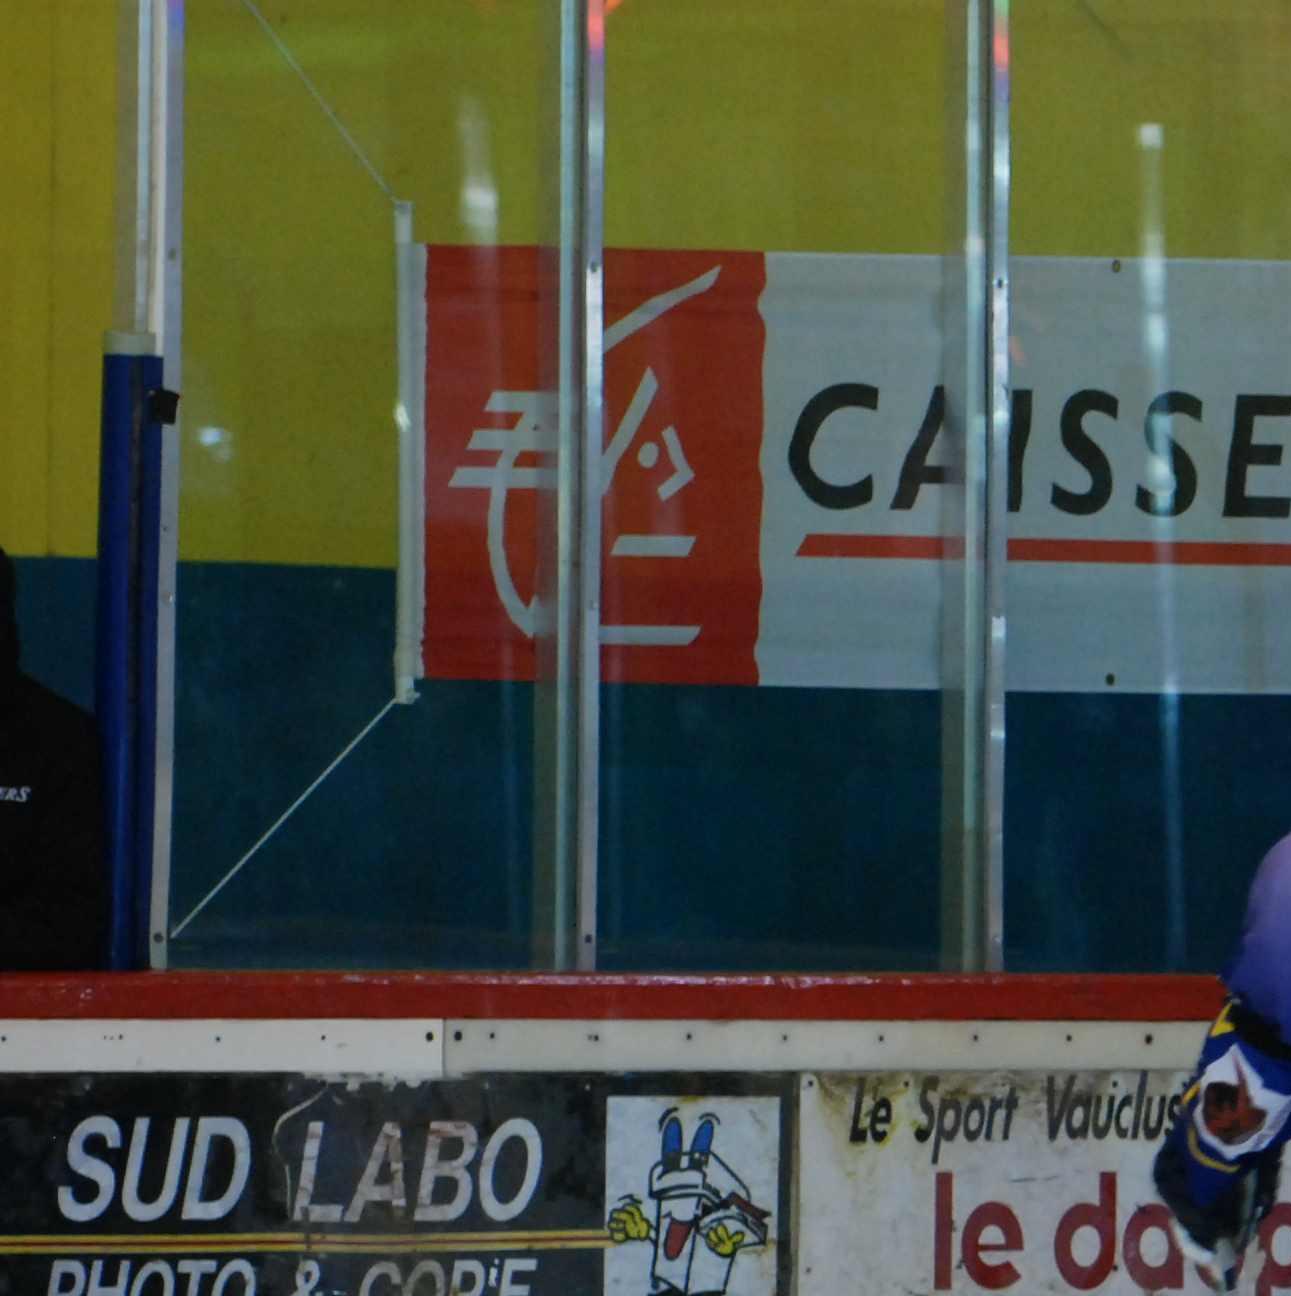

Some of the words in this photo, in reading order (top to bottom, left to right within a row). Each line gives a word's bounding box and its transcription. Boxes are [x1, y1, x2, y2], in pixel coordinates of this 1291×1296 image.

[57, 1115, 252, 1222] SUD
[293, 1117, 543, 1222] LABO
[849, 1076, 894, 1143] Le
[912, 1075, 1020, 1165] Sport
[1046, 1069, 1188, 1142] Vauclus
[934, 1171, 1024, 1291] le
